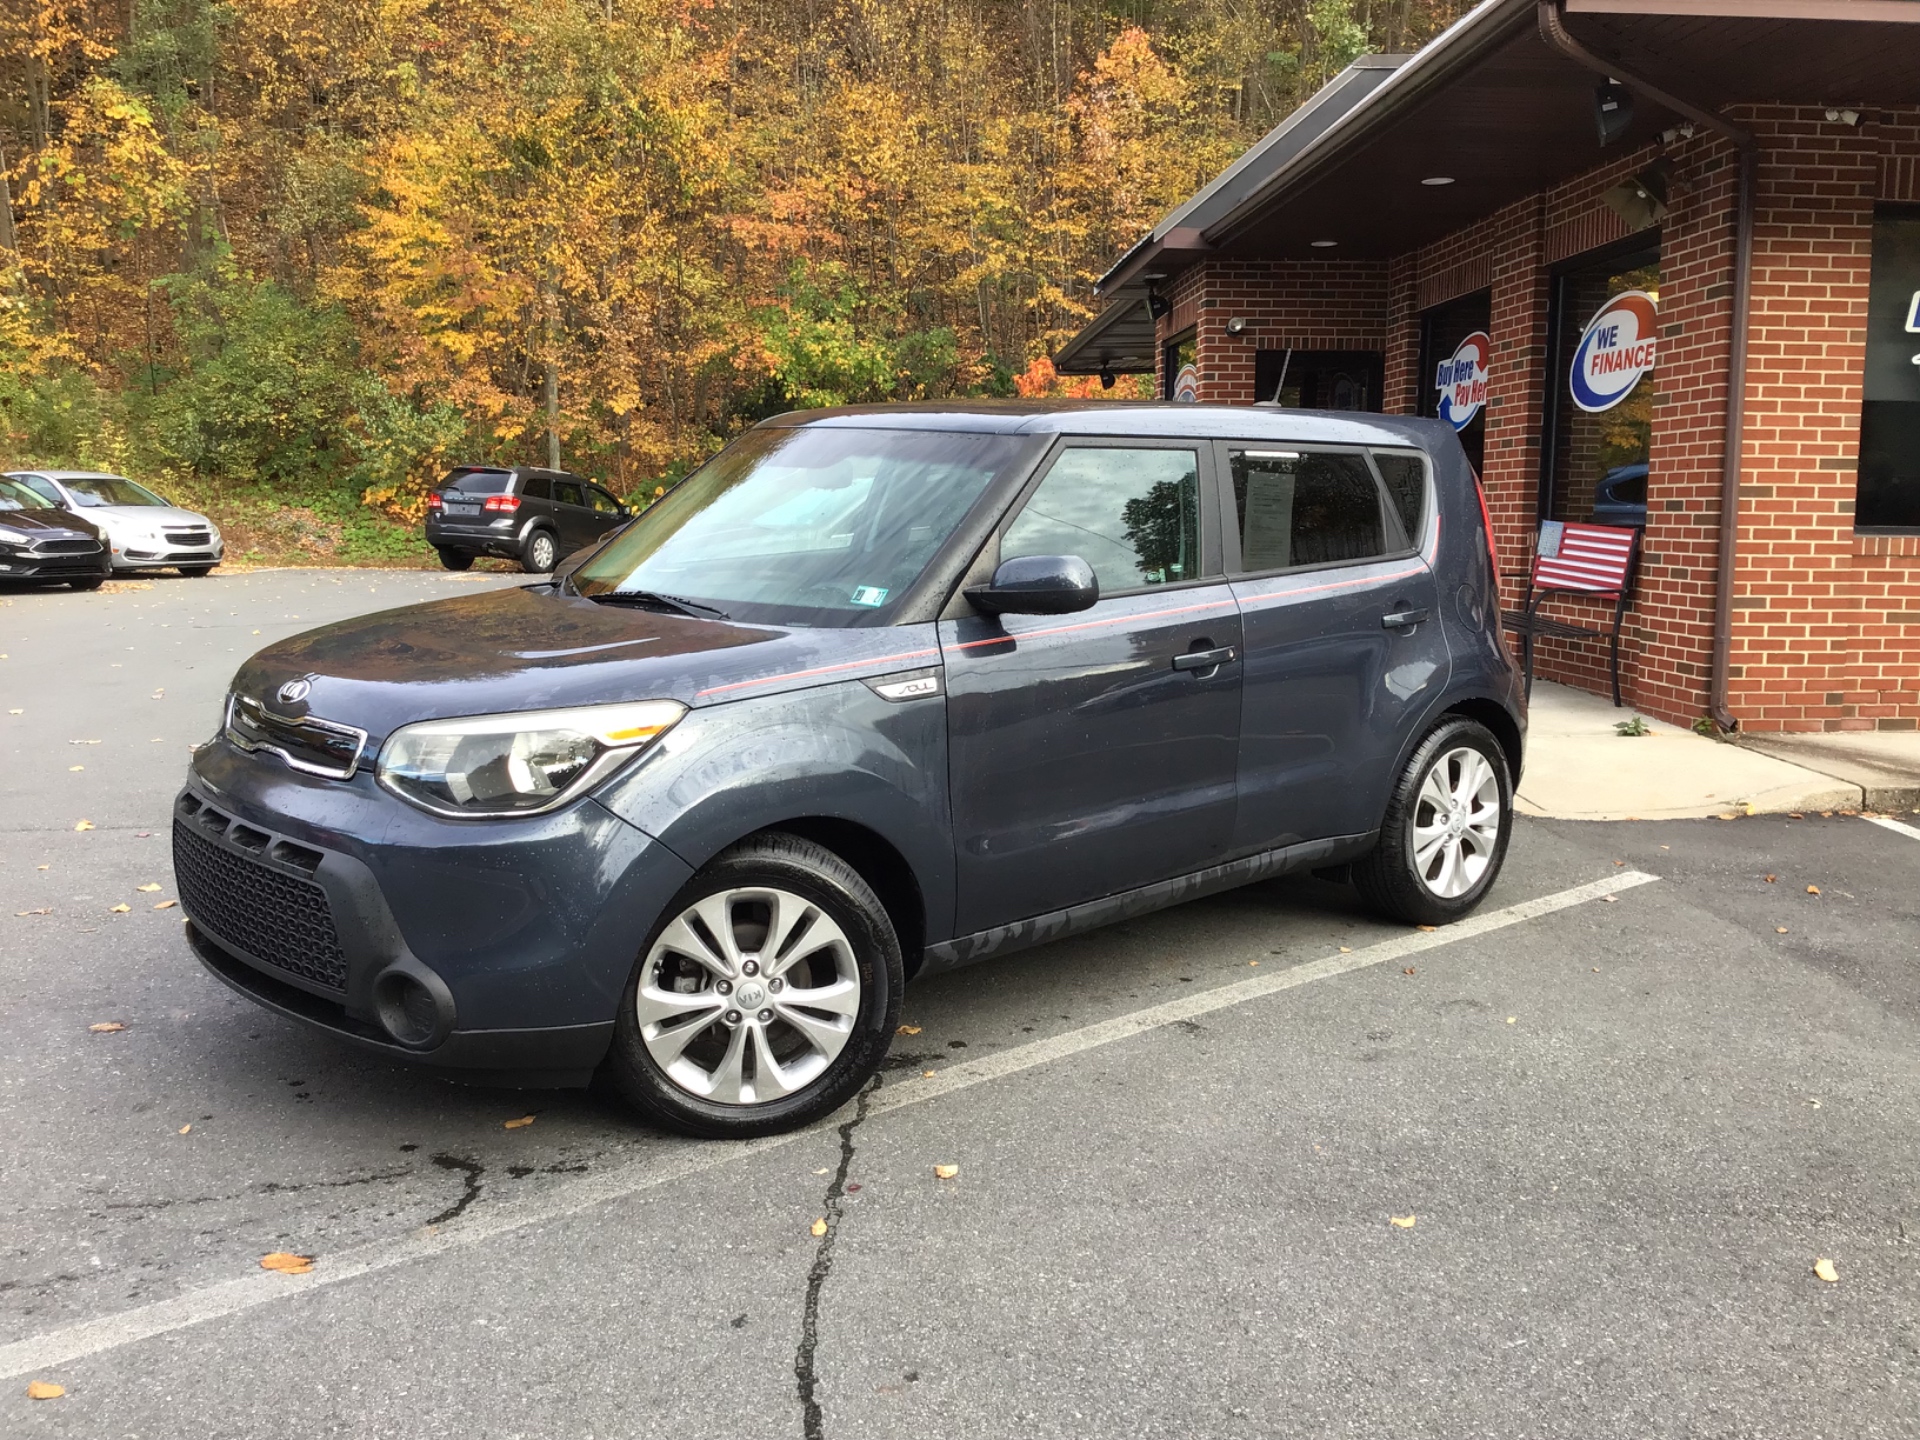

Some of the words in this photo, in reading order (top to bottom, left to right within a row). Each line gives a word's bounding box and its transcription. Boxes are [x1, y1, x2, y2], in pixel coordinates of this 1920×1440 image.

[1597, 324, 1619, 350] WE
[1437, 364, 1453, 387] Buy
[1453, 359, 1474, 383] Here
[1591, 343, 1655, 376] FINANCE
[1454, 383, 1471, 407] Pay
[1471, 379, 1487, 403] Her
[739, 990, 762, 1004] KIA
